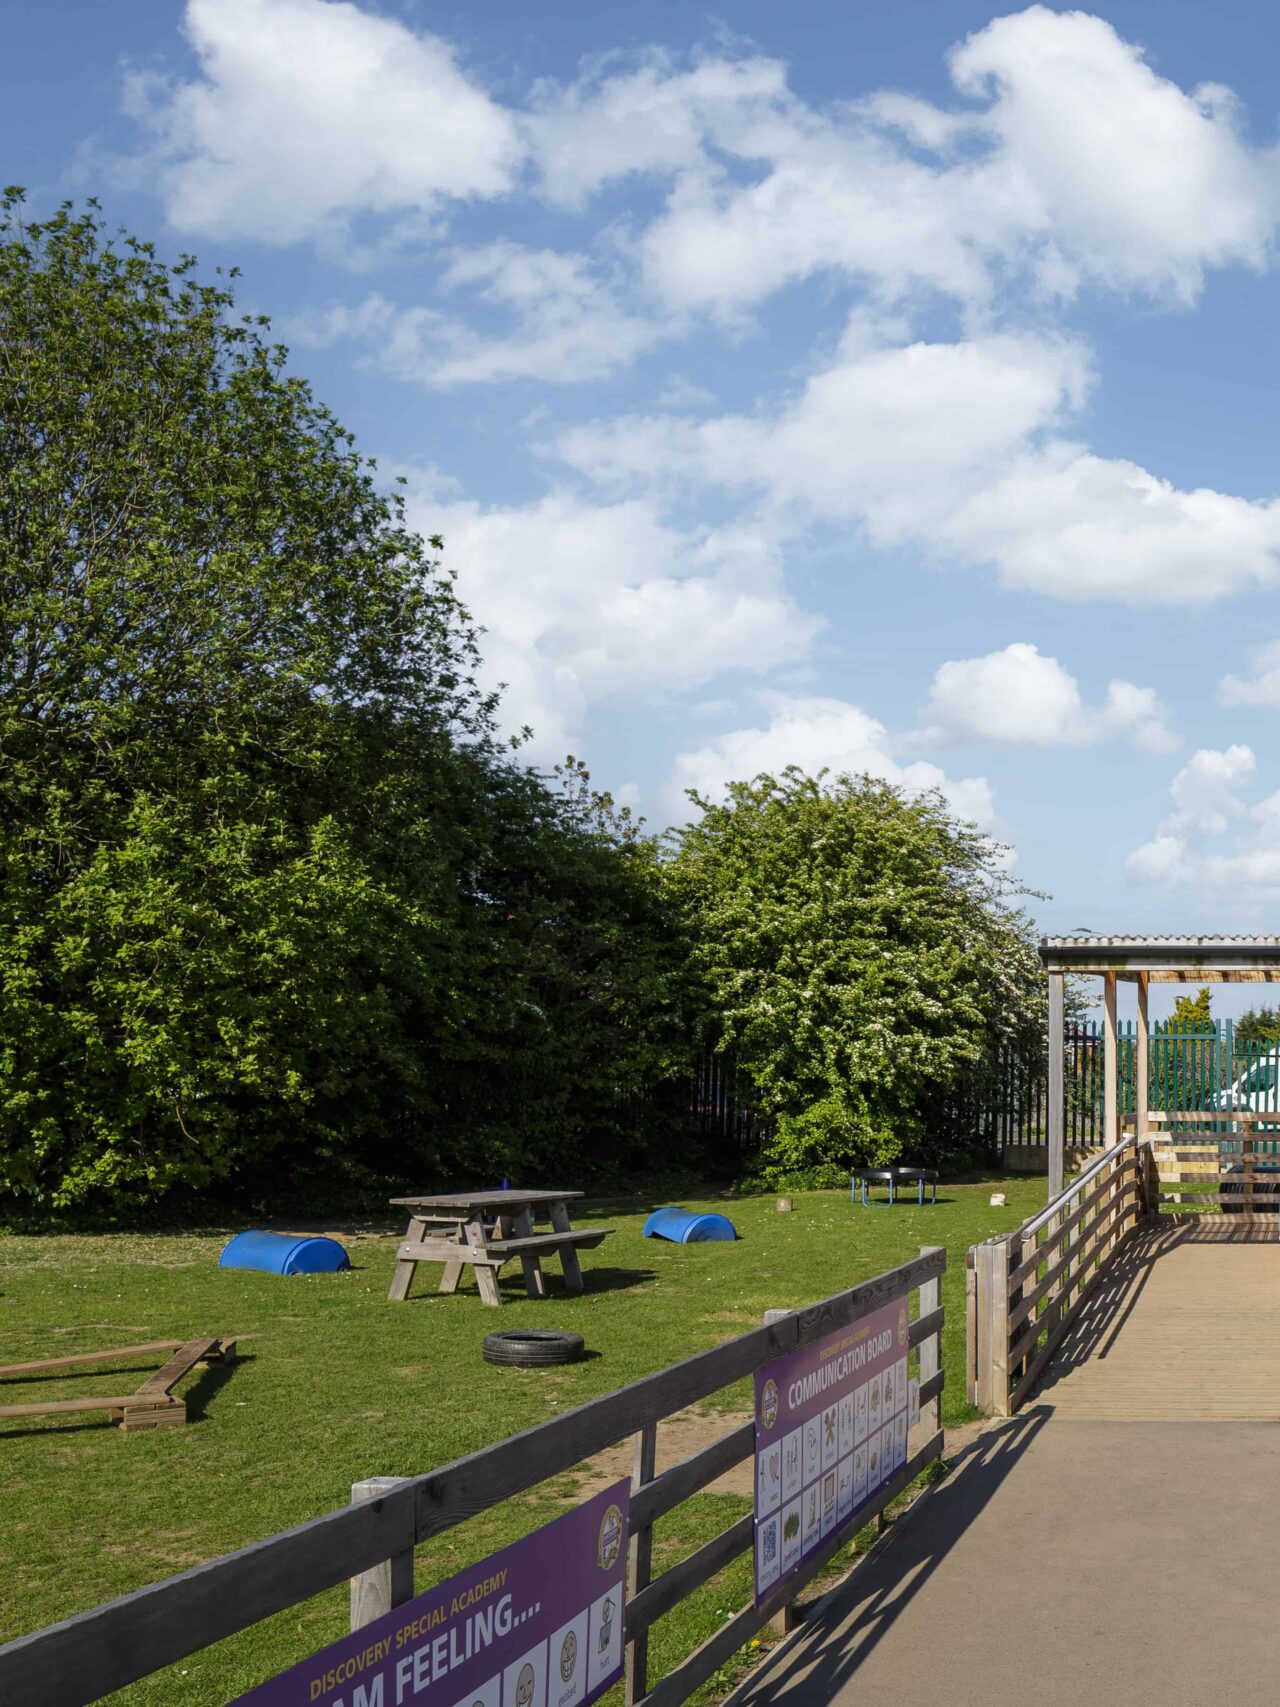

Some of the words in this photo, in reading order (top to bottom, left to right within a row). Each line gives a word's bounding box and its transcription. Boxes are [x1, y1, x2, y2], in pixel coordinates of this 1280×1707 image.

[788, 1343, 866, 1410] COMMUNICATION
[867, 1328, 893, 1363] BOARD
[310, 1635, 392, 1701] DISCOVERY
[396, 1605, 447, 1649] SPECIAL
[450, 1568, 508, 1617] ACADEMY
[396, 1593, 540, 1706] FEELING....
